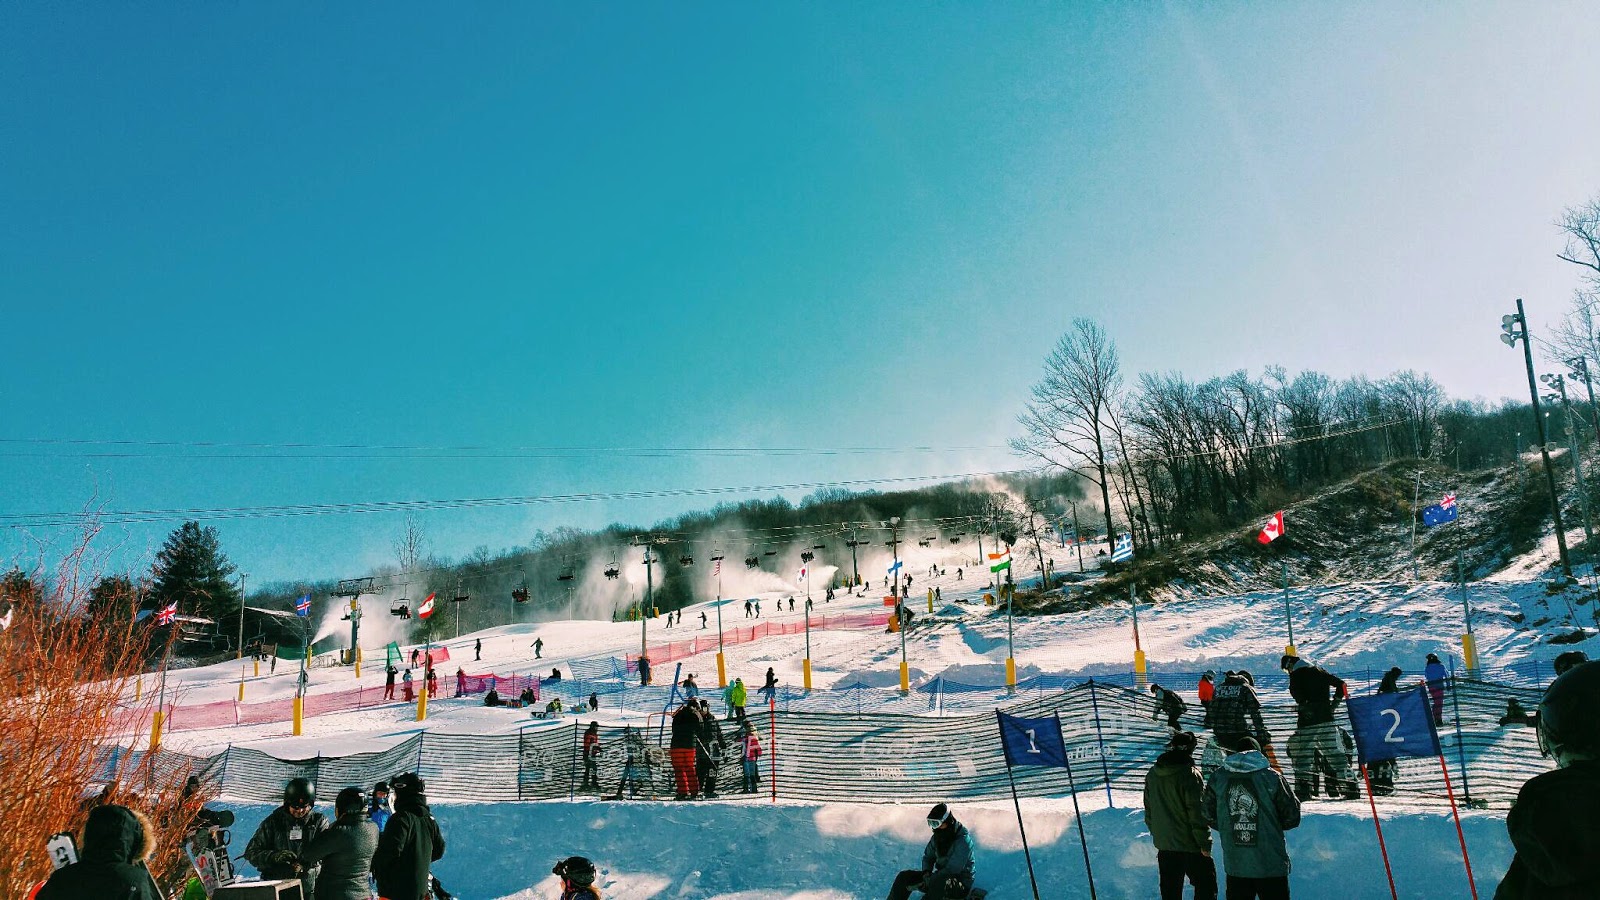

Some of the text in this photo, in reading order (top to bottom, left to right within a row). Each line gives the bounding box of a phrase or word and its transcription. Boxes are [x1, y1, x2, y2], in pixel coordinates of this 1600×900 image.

[1380, 708, 1405, 743] 2
[589, 742, 666, 765] GoPro
[1025, 728, 1041, 754] 1
